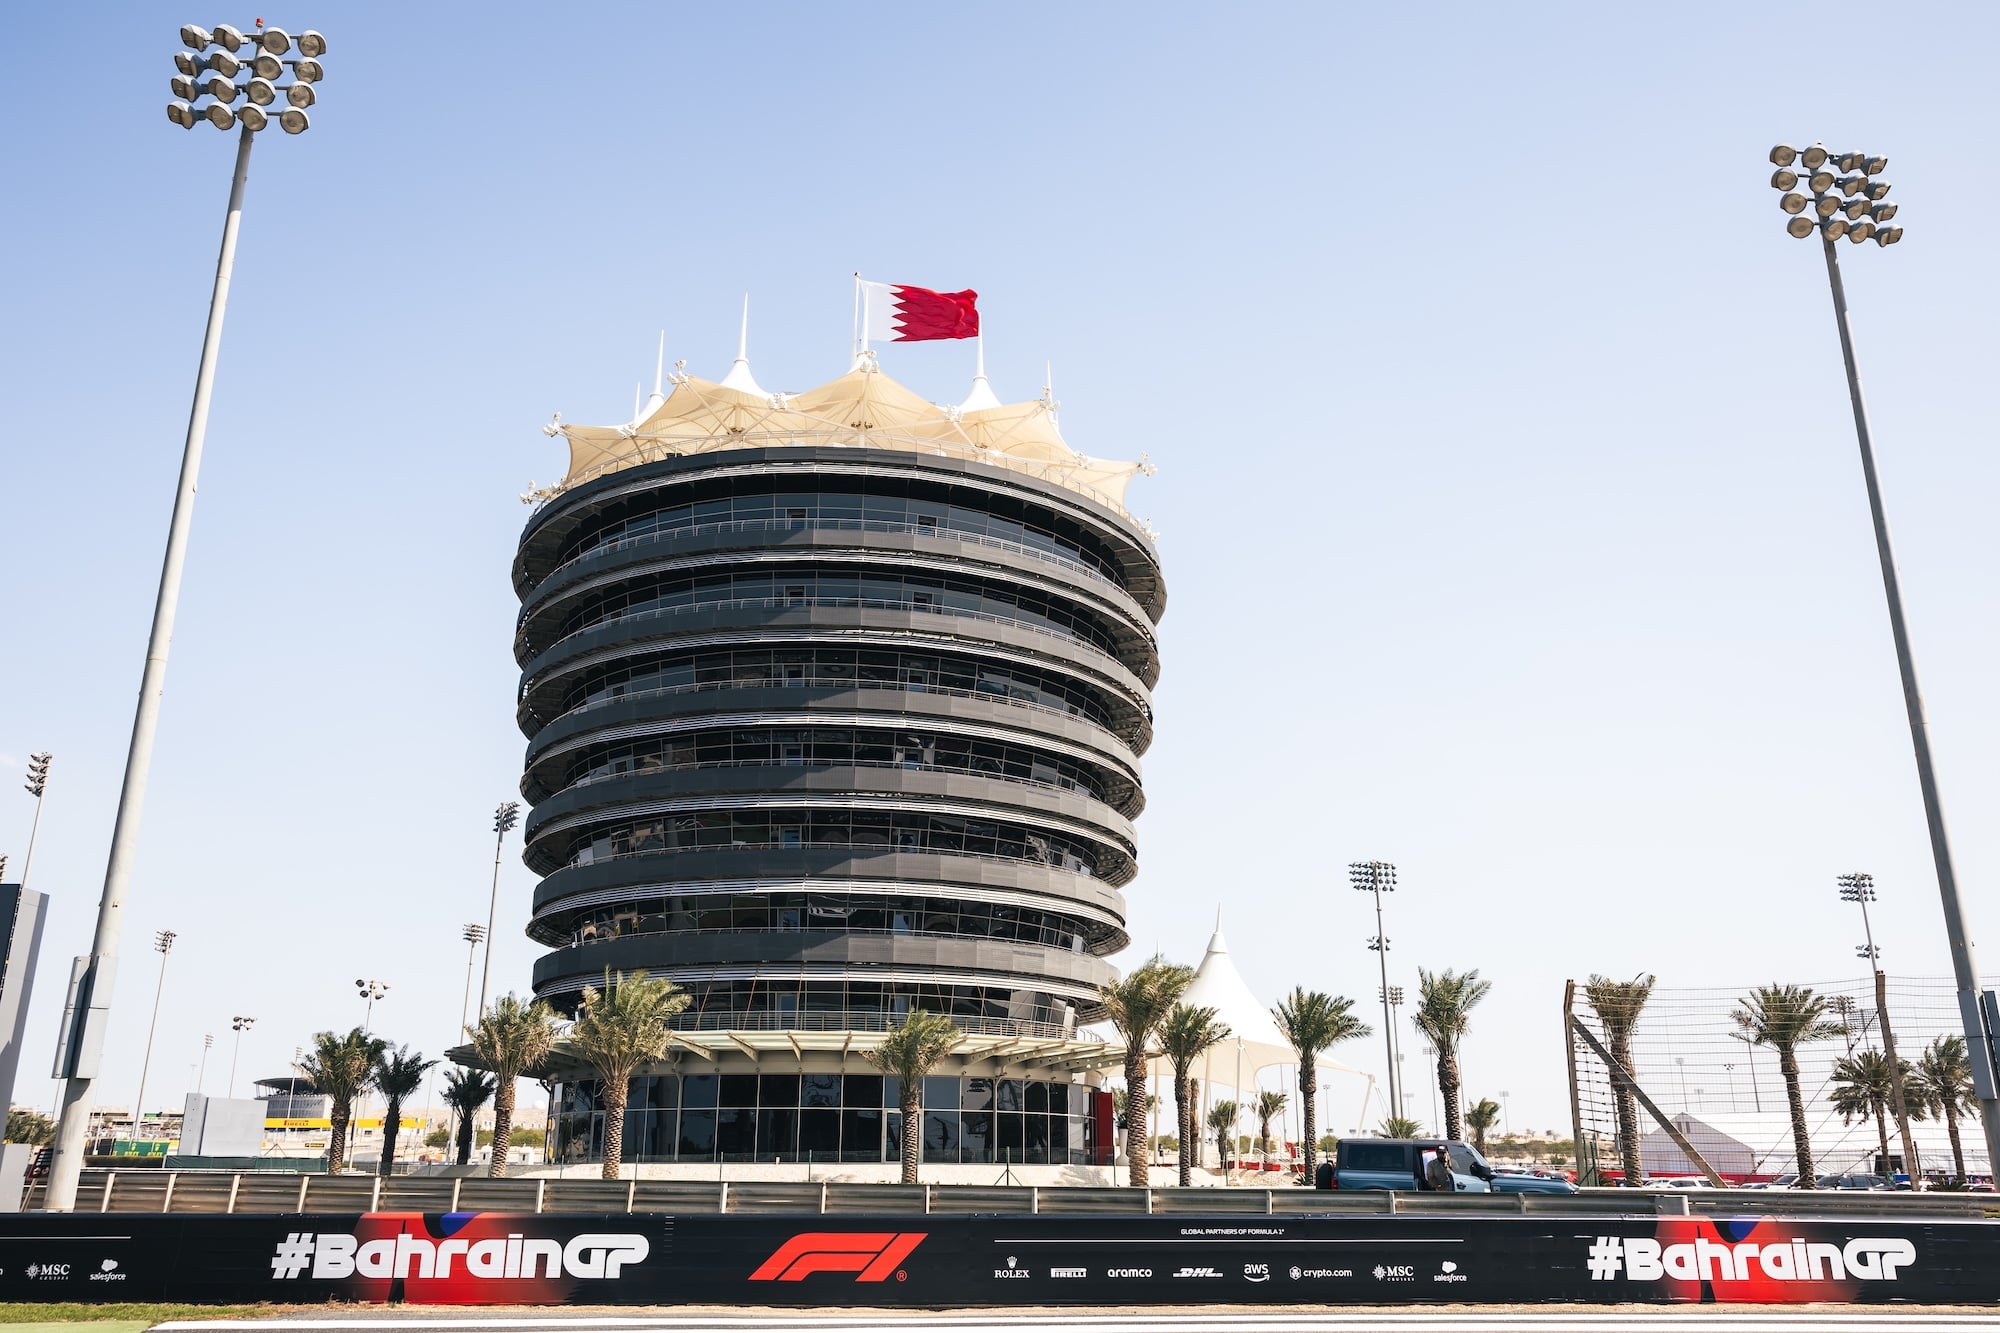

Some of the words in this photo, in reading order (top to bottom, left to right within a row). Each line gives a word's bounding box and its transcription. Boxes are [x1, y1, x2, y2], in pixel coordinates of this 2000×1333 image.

[270, 1232, 650, 1280] #BahrainGP
[1587, 1236, 1917, 1281] #BahrainGP
[40, 1263, 71, 1276] MSC
[994, 1269, 1031, 1279] ROLEX
[1050, 1267, 1088, 1278] PIRELLI
[1107, 1268, 1153, 1278] aramco
[1177, 1268, 1219, 1278] DHL
[1243, 1263, 1269, 1275] aws
[1303, 1268, 1353, 1279] crypto.com
[1386, 1265, 1414, 1277] MSC
[89, 1272, 127, 1282] salesforce
[1433, 1273, 1468, 1283] salesforce
